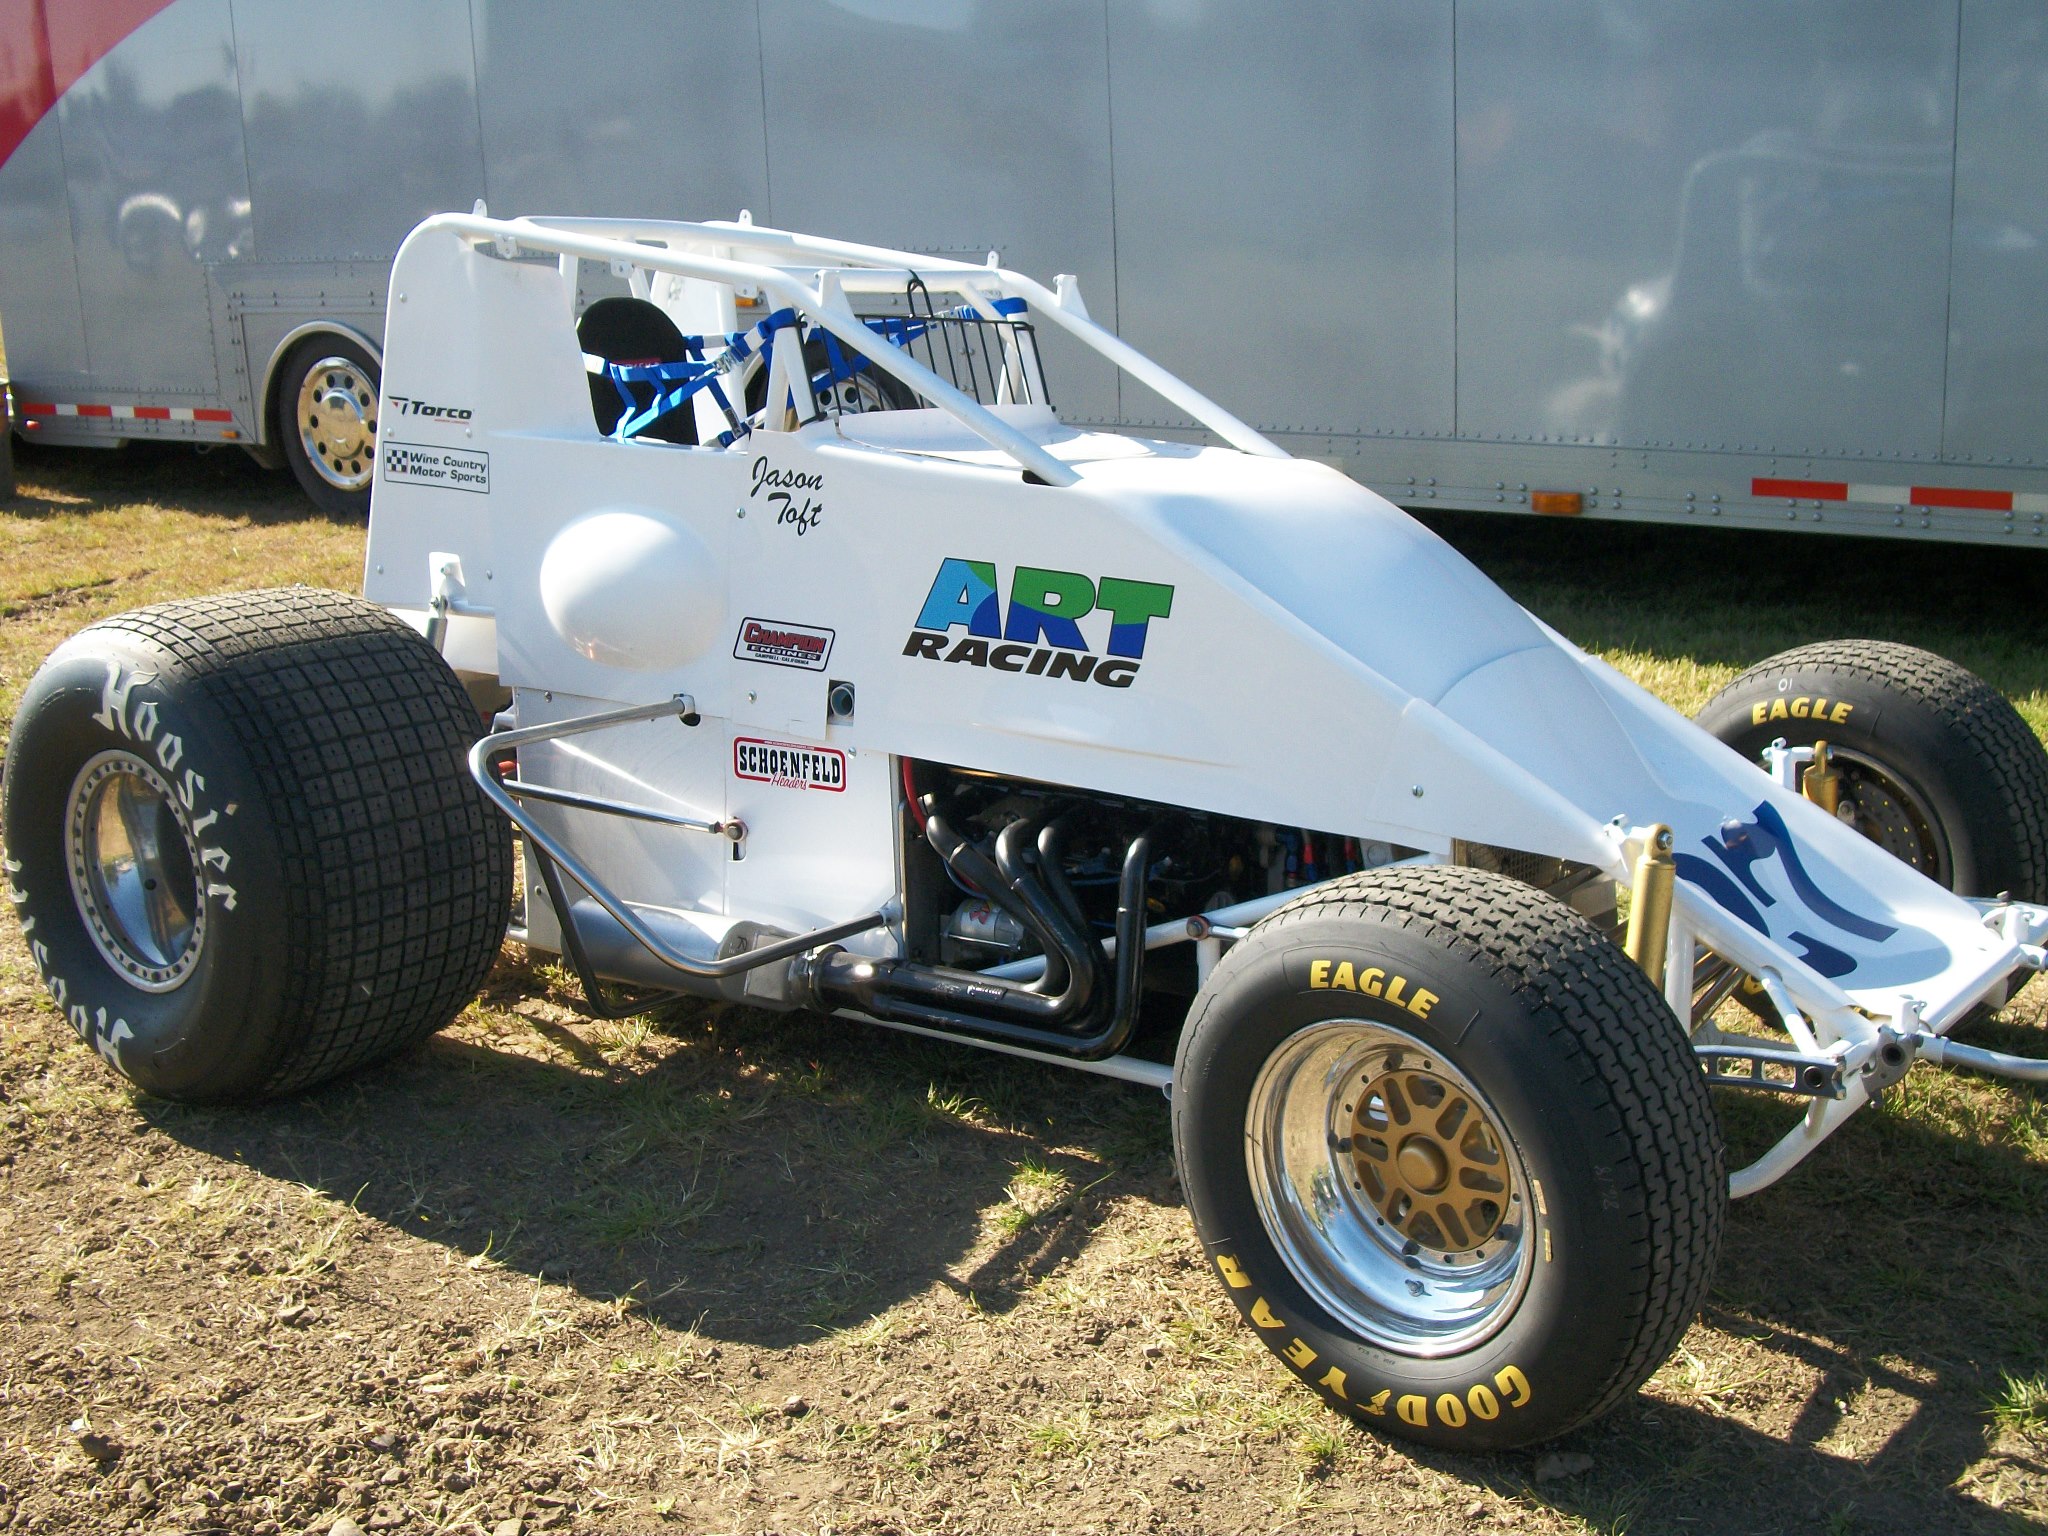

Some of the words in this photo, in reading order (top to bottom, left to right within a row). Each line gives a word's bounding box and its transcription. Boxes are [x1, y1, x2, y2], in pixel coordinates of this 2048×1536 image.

[411, 400, 473, 420] Torco
[410, 452, 439, 465] Wine
[443, 456, 486, 473] Country
[410, 465, 446, 478] Motor
[450, 469, 487, 484] Sports
[751, 455, 824, 498] Jason
[767, 491, 823, 537] Toft
[915, 556, 1175, 660] ART
[749, 645, 819, 661] ENGINES
[901, 631, 1143, 689] RACING
[1752, 696, 1854, 726] EAGLE
[739, 745, 841, 784] SCHOENFELD
[770, 770, 808, 791] Headers
[1309, 959, 1440, 1020] EAGLE
[1216, 1252, 1532, 1428] GOODYEAR
